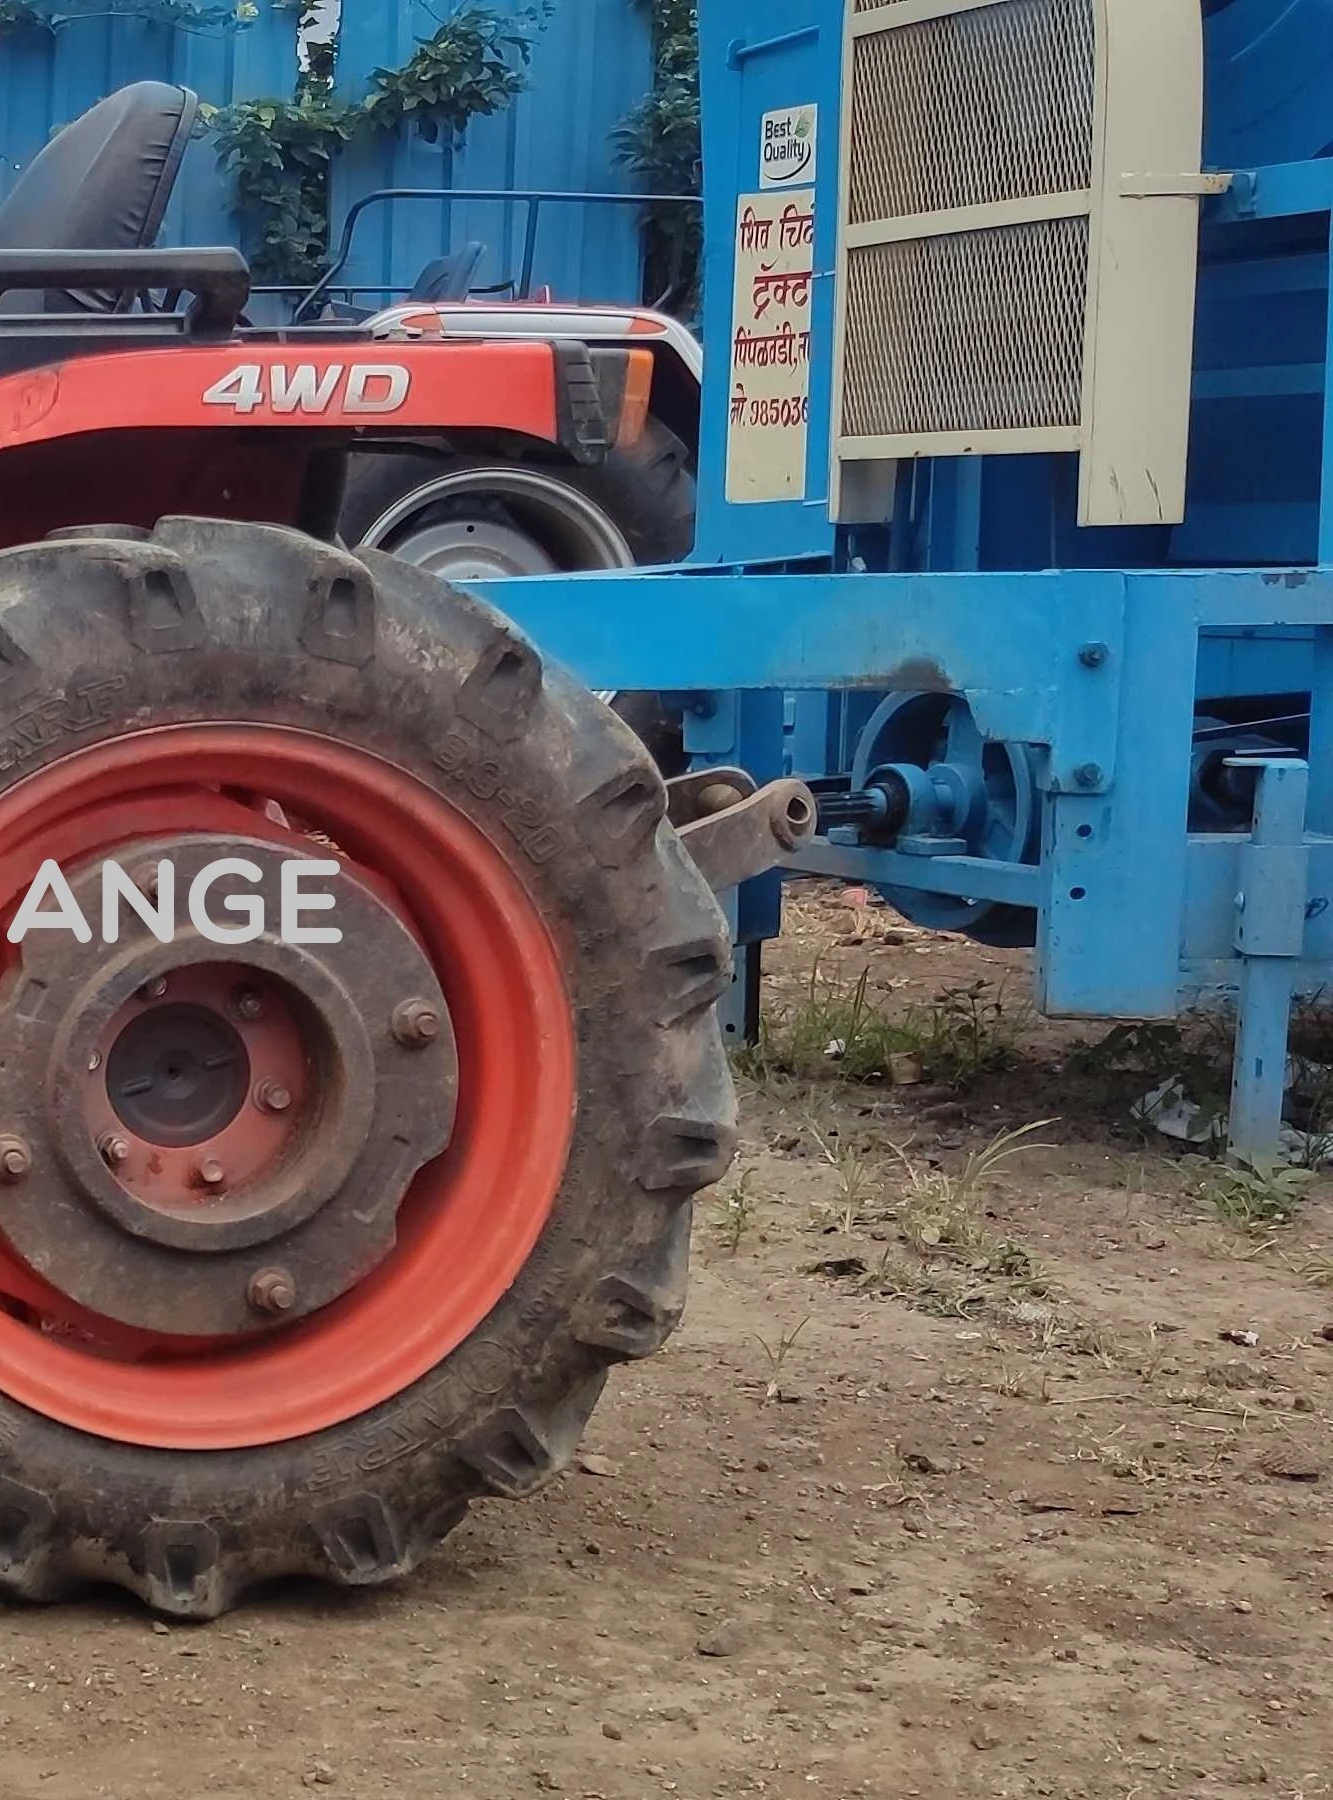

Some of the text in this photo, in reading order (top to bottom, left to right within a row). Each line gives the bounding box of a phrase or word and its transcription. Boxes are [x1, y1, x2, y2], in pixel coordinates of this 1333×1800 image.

[765, 116, 791, 139] Best
[764, 139, 805, 162] Quality
[202, 363, 411, 414] 4WD
